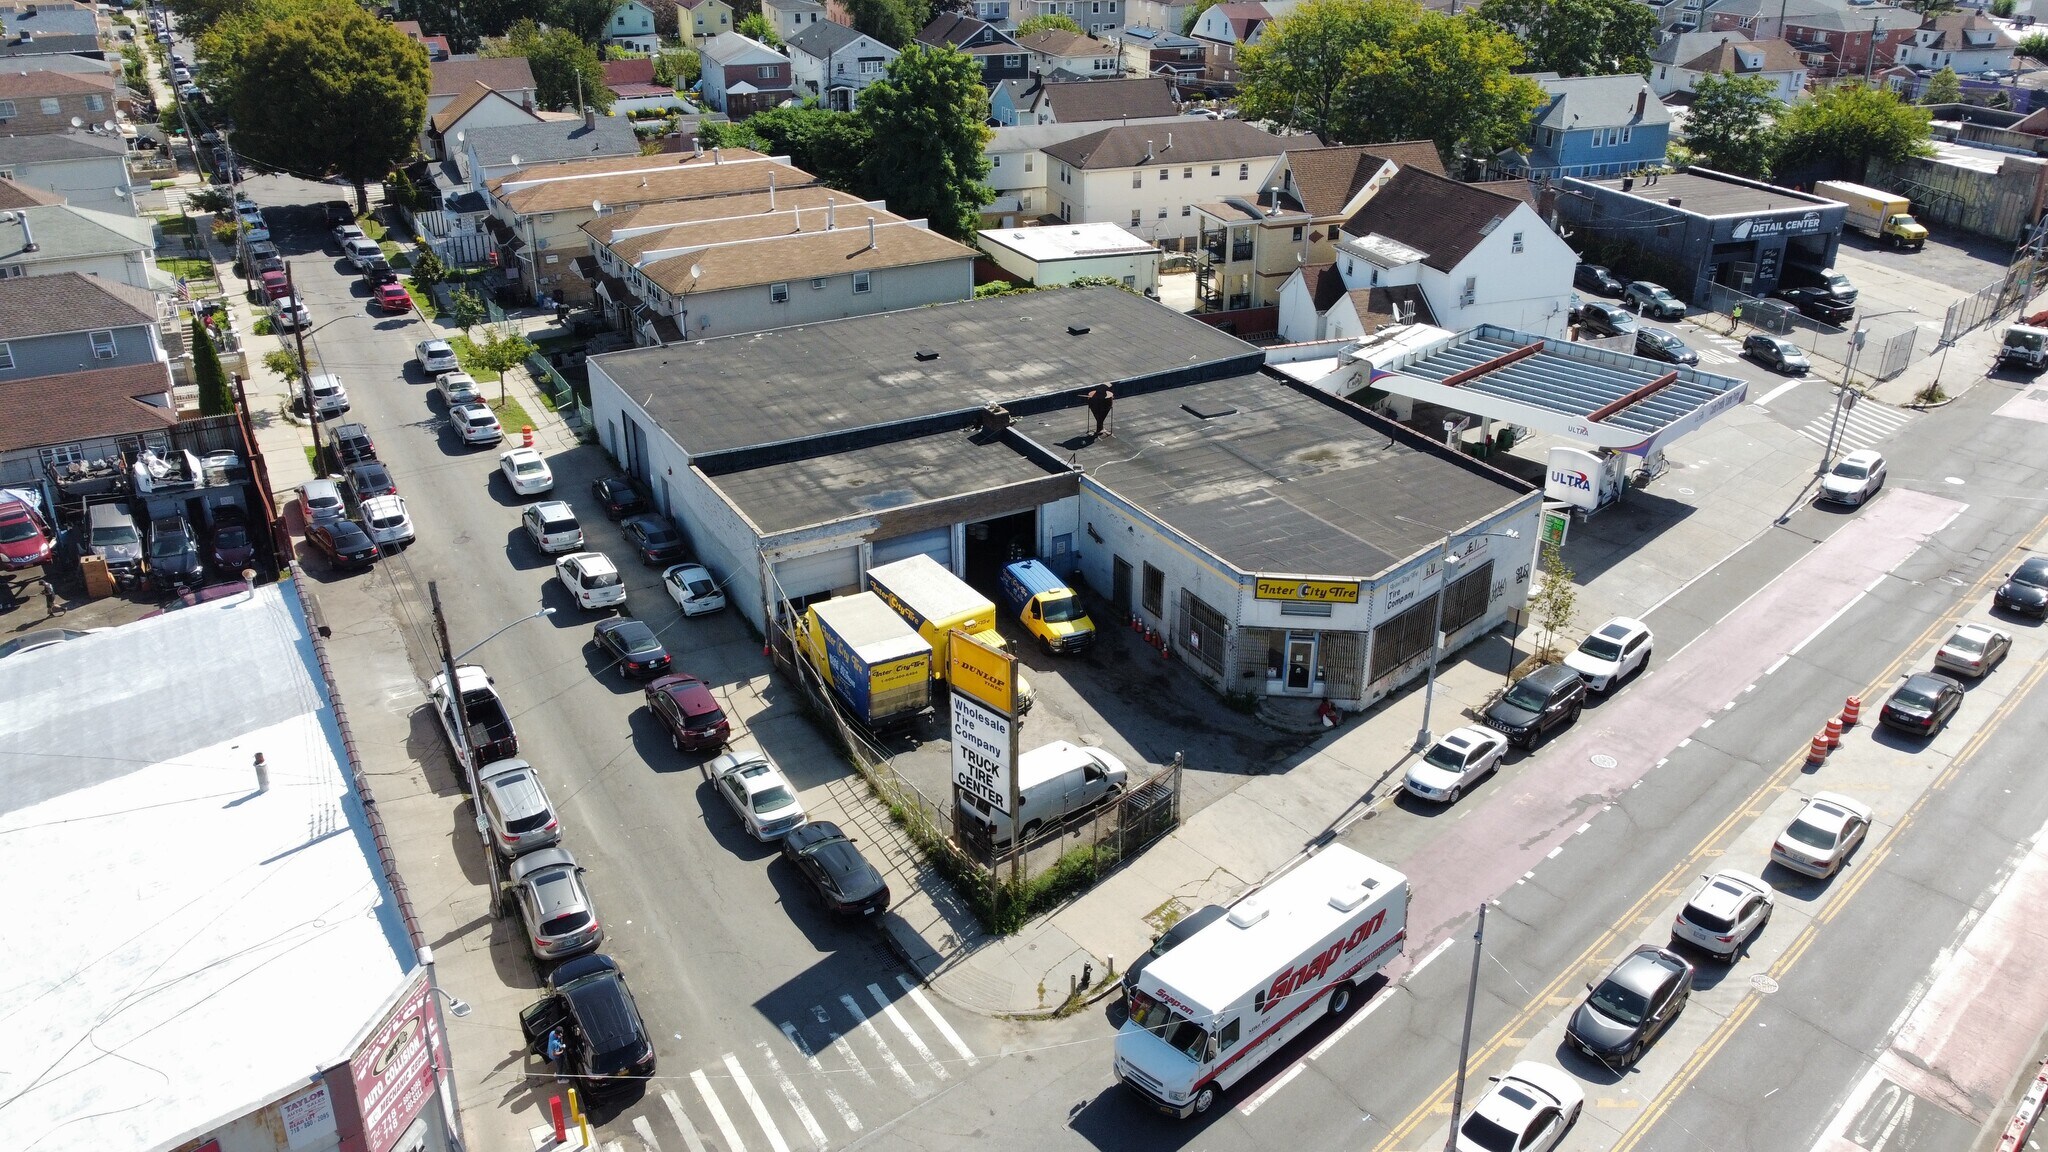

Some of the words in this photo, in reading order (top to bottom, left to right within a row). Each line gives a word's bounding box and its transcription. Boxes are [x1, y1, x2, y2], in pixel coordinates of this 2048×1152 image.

[1752, 222, 1784, 233] DETAIL
[1785, 219, 1820, 230] CENTER
[1568, 426, 1589, 437] ULTRA
[1551, 469, 1590, 491] ULTRA
[870, 580, 889, 599] Inter
[890, 596, 905, 615] City
[1258, 584, 1295, 595] Inter
[1301, 584, 1327, 598] City
[1329, 587, 1356, 597] Tire
[1387, 590, 1414, 610] Company
[1388, 589, 1401, 600] Tire
[872, 668, 893, 678] Inter
[896, 662, 910, 673] City
[910, 660, 925, 669] Tire
[961, 662, 1005, 687] DUNLOP
[985, 680, 1003, 692] TIRES
[954, 698, 1006, 734] Wholesale
[955, 711, 975, 730] Tire
[955, 724, 1001, 758] Company
[960, 745, 1000, 778] TRUCK
[967, 763, 994, 788] TIRE
[958, 772, 1004, 808] CENTER
[1261, 908, 1387, 1016] Snap-on
[1155, 988, 1194, 1015] Snap-on
[357, 994, 431, 1081] TAYLOR
[364, 1080, 384, 1113] AUTO
[385, 1035, 420, 1086] COLLISION
[284, 1089, 325, 1113] TAYLOR
[379, 1069, 410, 1114] MECHANIC
[287, 1107, 303, 1118] AUTO
[306, 1096, 326, 1108] SALES
[382, 1107, 397, 1130] 718
[383, 1118, 398, 1139] 718
